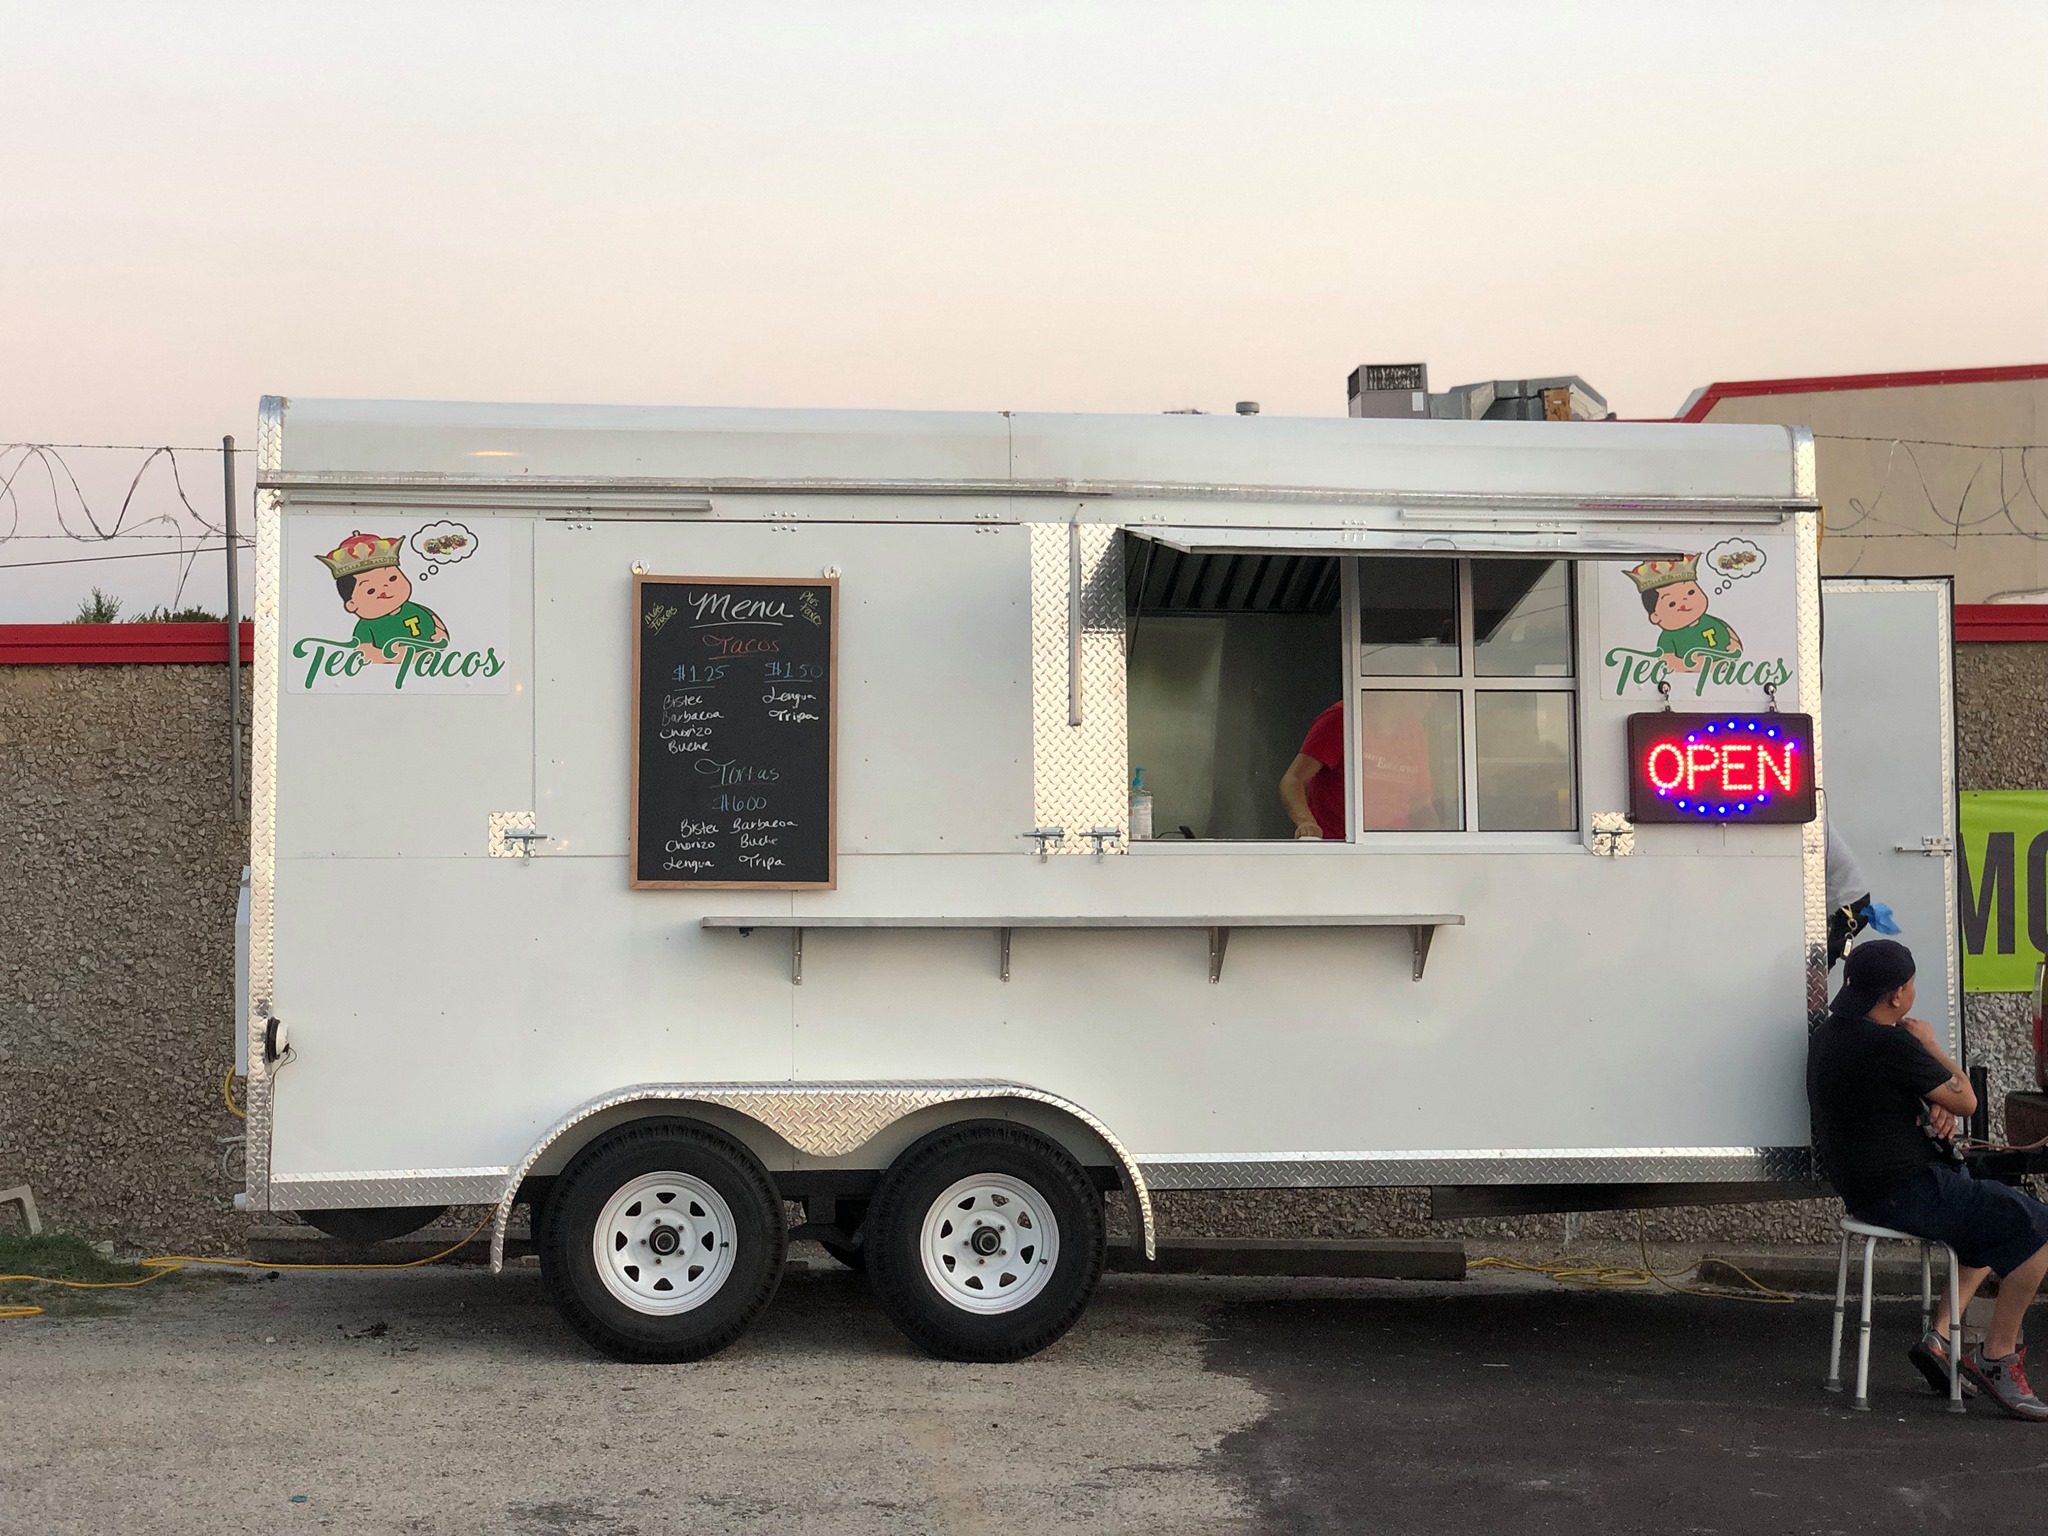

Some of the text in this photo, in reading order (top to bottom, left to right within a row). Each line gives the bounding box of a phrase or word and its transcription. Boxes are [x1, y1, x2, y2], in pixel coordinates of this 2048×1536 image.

[688, 592, 794, 621] Menu
[702, 634, 780, 655] Tacos
[292, 637, 505, 689] Teo Tacos
[1605, 647, 1793, 696] Teo Tacos
[662, 695, 703, 710] Bistec
[762, 686, 817, 709] Lengua
[662, 710, 724, 726] Barbacoa
[768, 709, 819, 723] Tripa
[660, 725, 712, 739] Chorizo
[694, 758, 780, 785] Tortas
[1648, 743, 1791, 791] OPEN
[680, 817, 798, 838] Bistec Barbacoa
[665, 833, 779, 853] Chorizo Buche
[663, 853, 786, 873] Lengua Tripa
